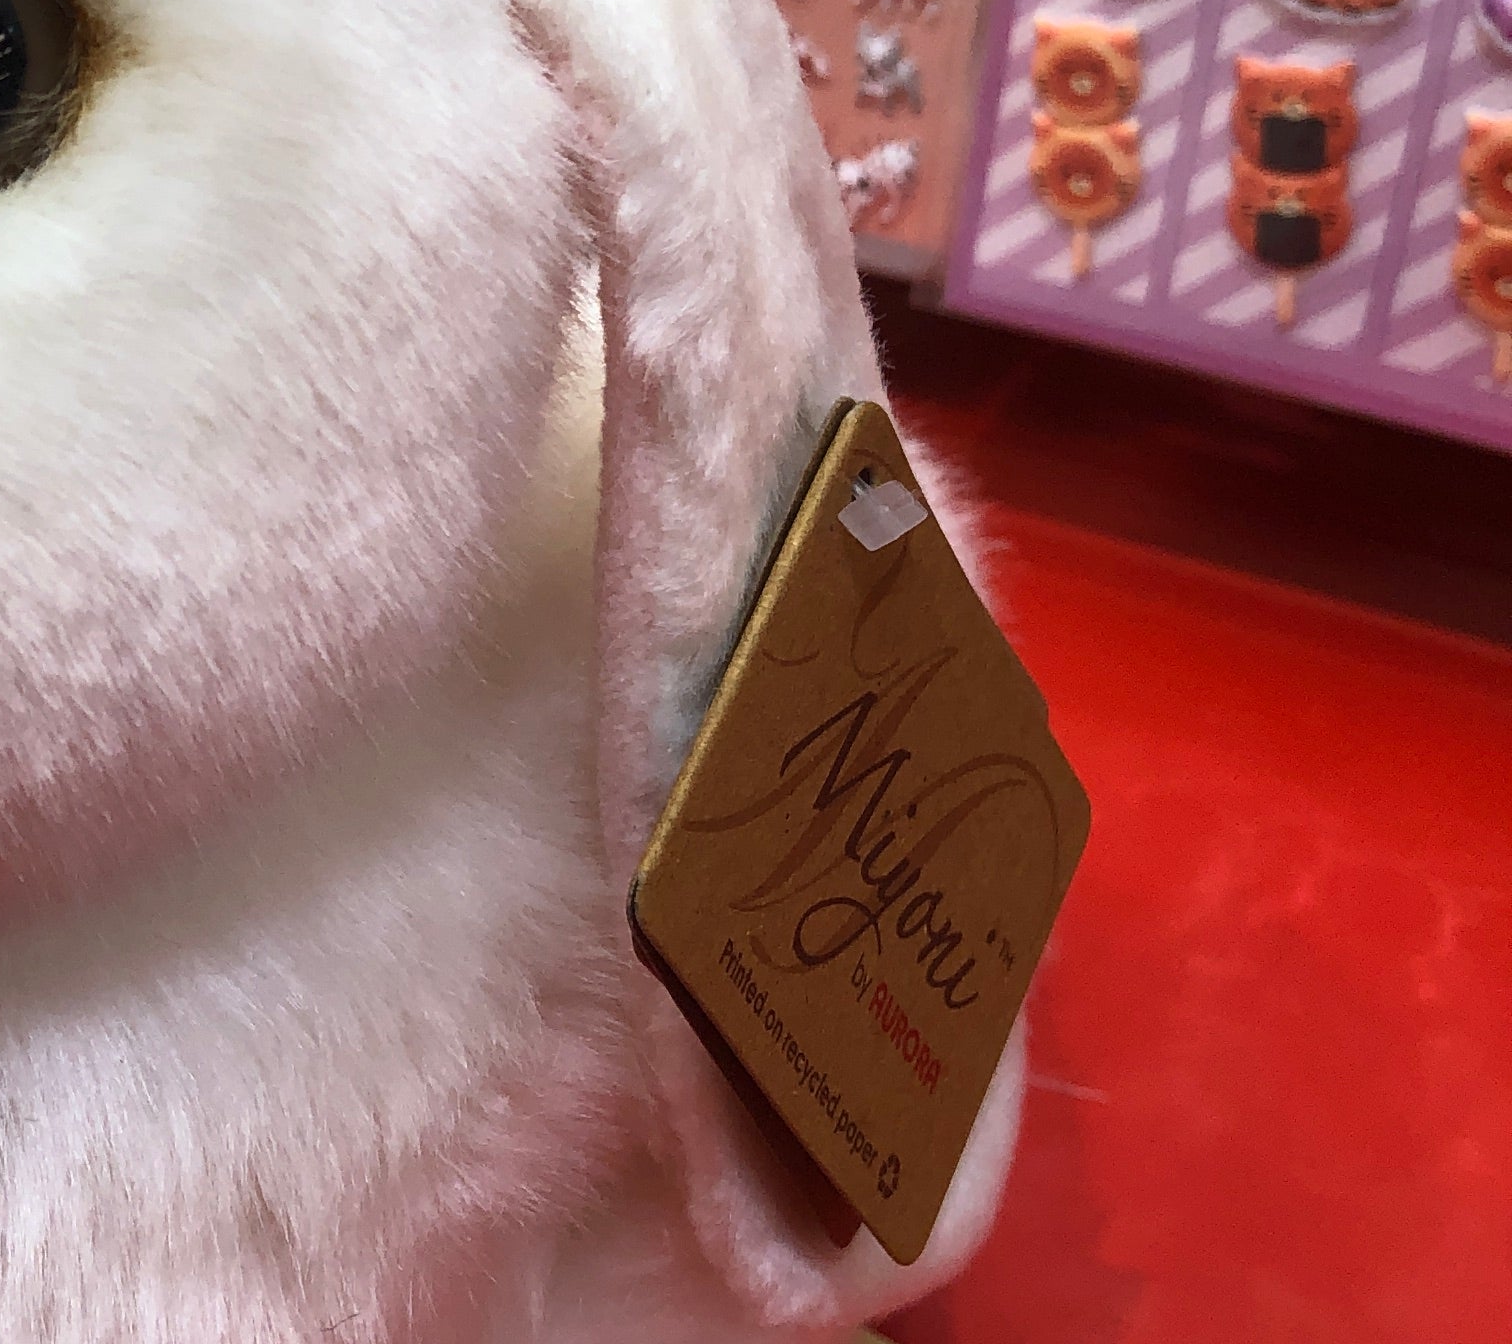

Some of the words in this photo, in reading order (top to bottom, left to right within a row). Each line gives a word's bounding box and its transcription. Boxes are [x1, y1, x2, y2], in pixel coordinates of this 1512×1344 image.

[779, 691, 996, 1010] Miyoni
[718, 938, 768, 1017] Printed
[764, 1009, 785, 1043] on
[780, 1033, 842, 1118] recycled
[834, 1109, 879, 1168] paper
[851, 952, 872, 1003] by
[869, 981, 945, 1095] AURORA
